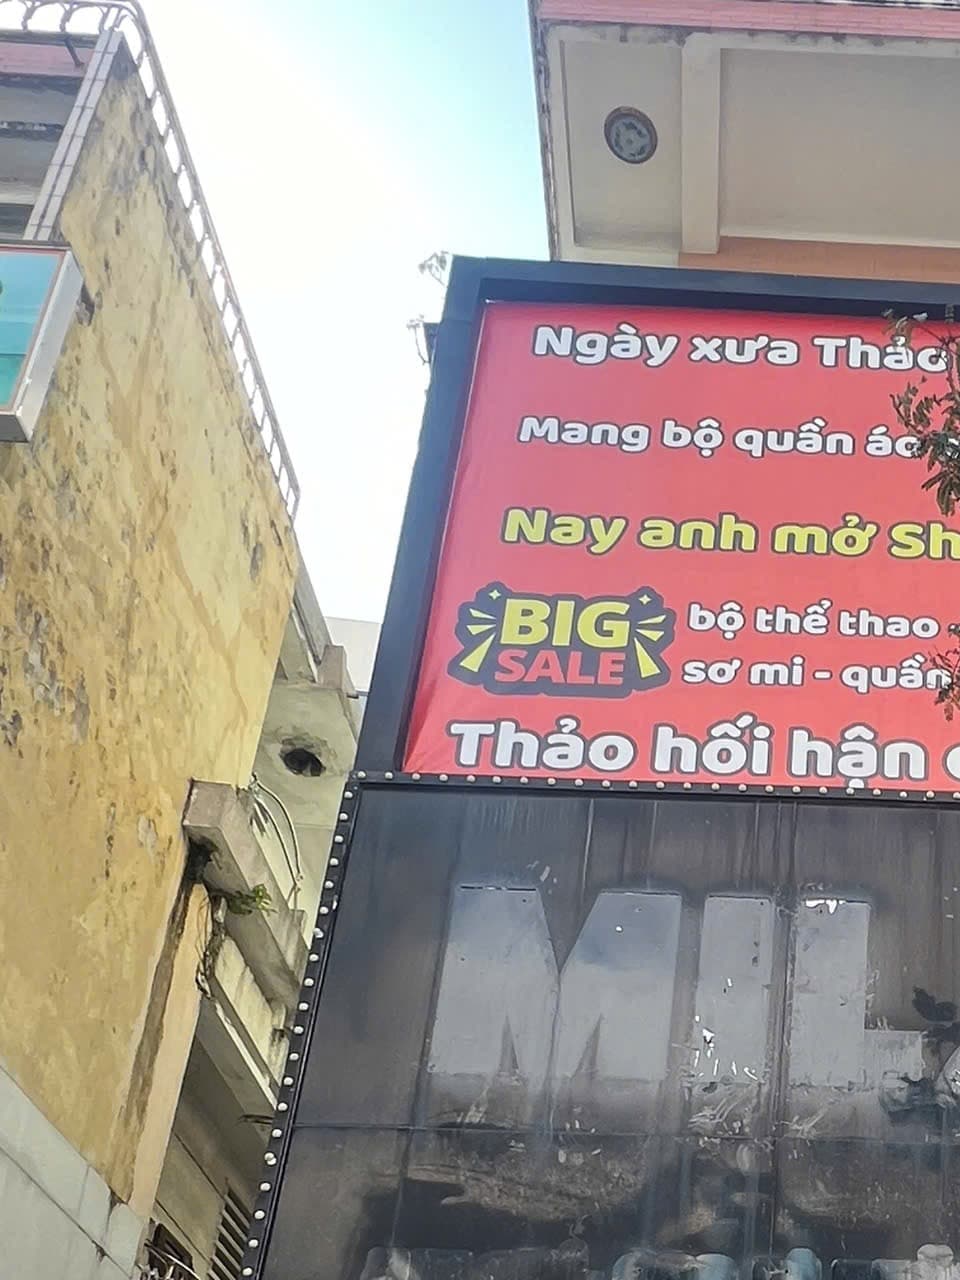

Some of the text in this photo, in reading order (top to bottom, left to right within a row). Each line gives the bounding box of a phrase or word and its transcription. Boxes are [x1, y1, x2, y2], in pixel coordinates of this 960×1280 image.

[533, 322, 679, 366] Ngày
[690, 334, 799, 365] xưa
[812, 335, 949, 372] Thảo
[518, 416, 650, 453] Mang
[662, 419, 724, 457] bộ
[735, 417, 854, 458] quần
[865, 425, 922, 457] áo
[503, 508, 626, 554] Nay
[639, 515, 756, 552] anh
[773, 515, 876, 556] mở
[500, 599, 632, 648] BIG
[688, 602, 745, 640] bộ
[755, 600, 832, 635] thể
[838, 609, 940, 639] thao
[495, 648, 625, 686] SALE
[682, 658, 741, 684] sơ
[749, 656, 805, 686] mi
[841, 653, 951, 692] quần
[449, 717, 635, 771] Thảo
[653, 713, 771, 775] hối
[790, 724, 926, 789] hận
